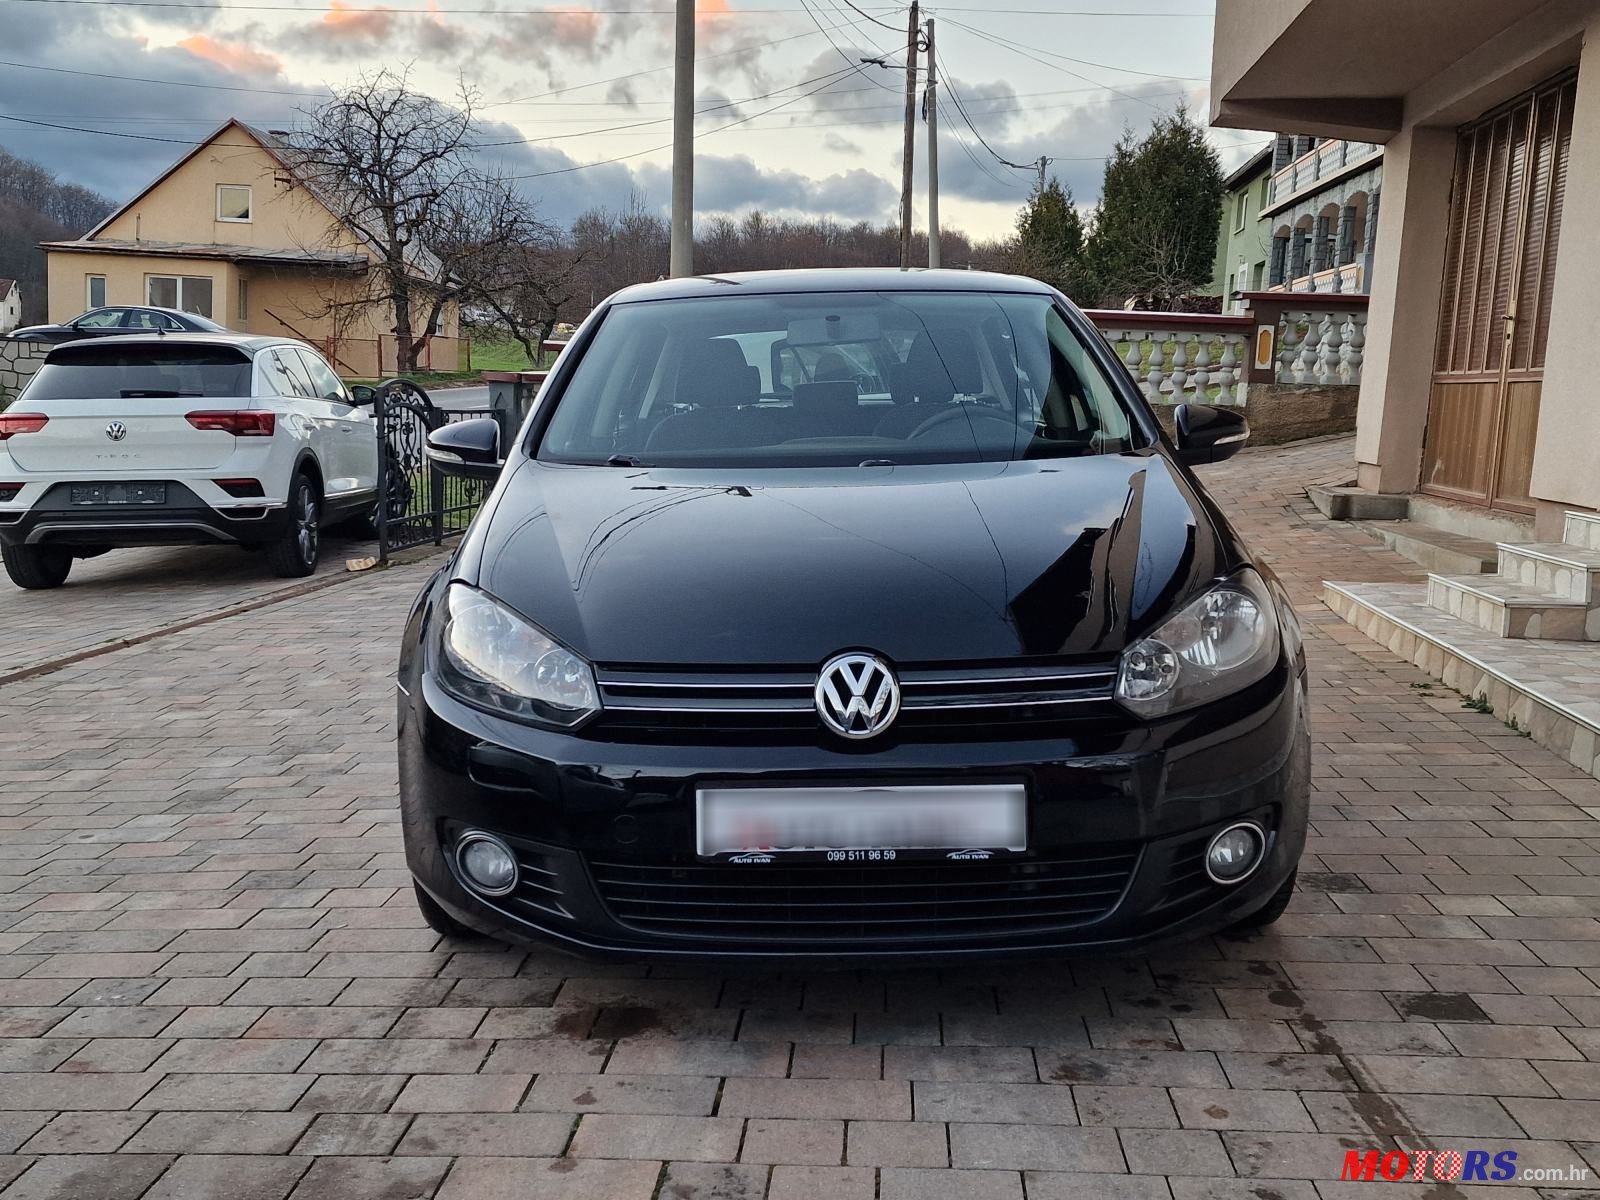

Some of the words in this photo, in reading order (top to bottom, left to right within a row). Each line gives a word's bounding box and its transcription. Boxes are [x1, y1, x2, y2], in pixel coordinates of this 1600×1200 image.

[816, 653, 899, 738] VW
[827, 850, 846, 861] 099
[848, 850, 865, 861] 511
[868, 850, 881, 860] 96
[883, 850, 896, 860] 59
